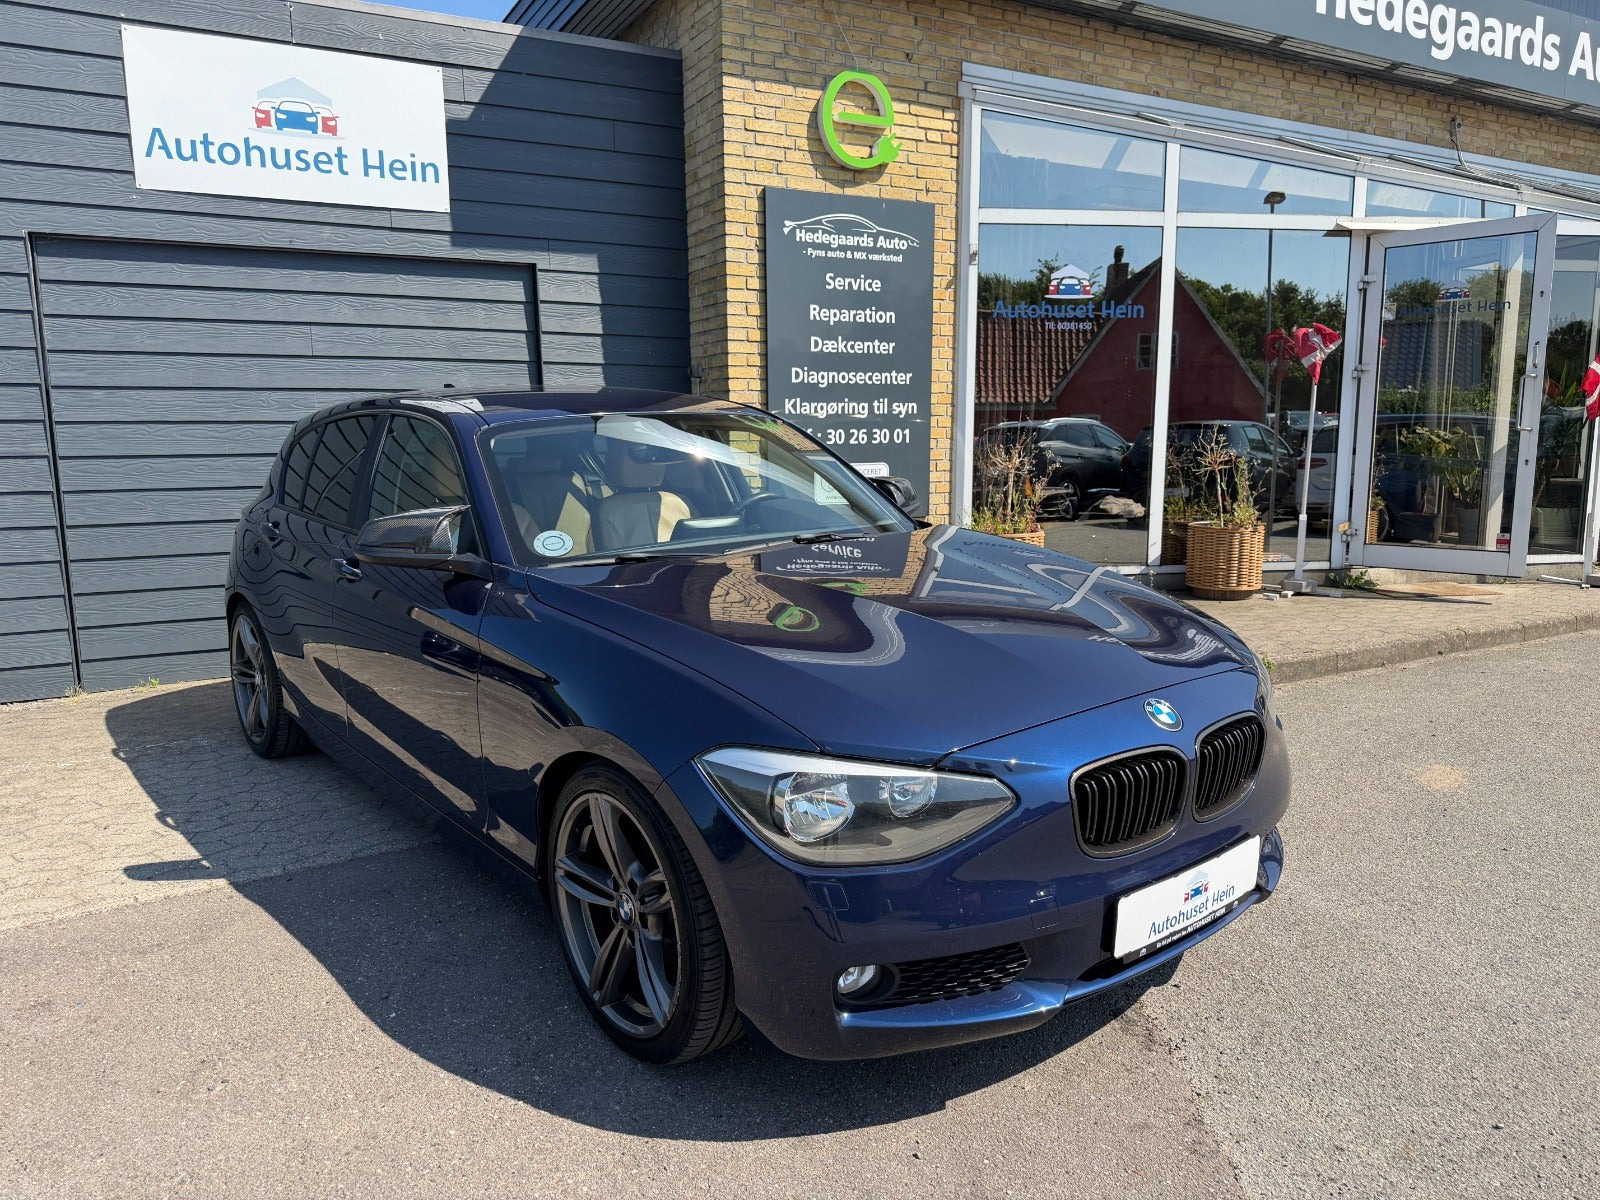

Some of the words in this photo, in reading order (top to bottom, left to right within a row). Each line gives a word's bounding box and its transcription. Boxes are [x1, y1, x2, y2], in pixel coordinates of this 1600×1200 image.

[145, 127, 349, 176] Autohuset
[361, 147, 440, 184] Hein
[795, 228, 874, 248] Hedegaards
[876, 235, 908, 250] Auto
[807, 248, 826, 258] Fyns
[826, 251, 845, 259] auto
[846, 251, 853, 259] &
[853, 252, 867, 260] MX
[868, 253, 903, 262] værksted
[825, 272, 882, 292] Service
[809, 304, 896, 325] Reparation
[992, 300, 1096, 319] Autohuset
[1101, 300, 1145, 319] Hein
[810, 335, 896, 355] Dækcenter
[791, 367, 913, 388] Diagnosecenter
[784, 398, 869, 419] Klargøring
[872, 398, 888, 415] til
[892, 401, 918, 419] syn
[826, 428, 846, 445] 30
[849, 428, 868, 444] 26
[871, 428, 890, 444] 30
[893, 428, 910, 444] 01
[1148, 899, 1210, 938] Autohuset
[1211, 885, 1235, 908] Hein
